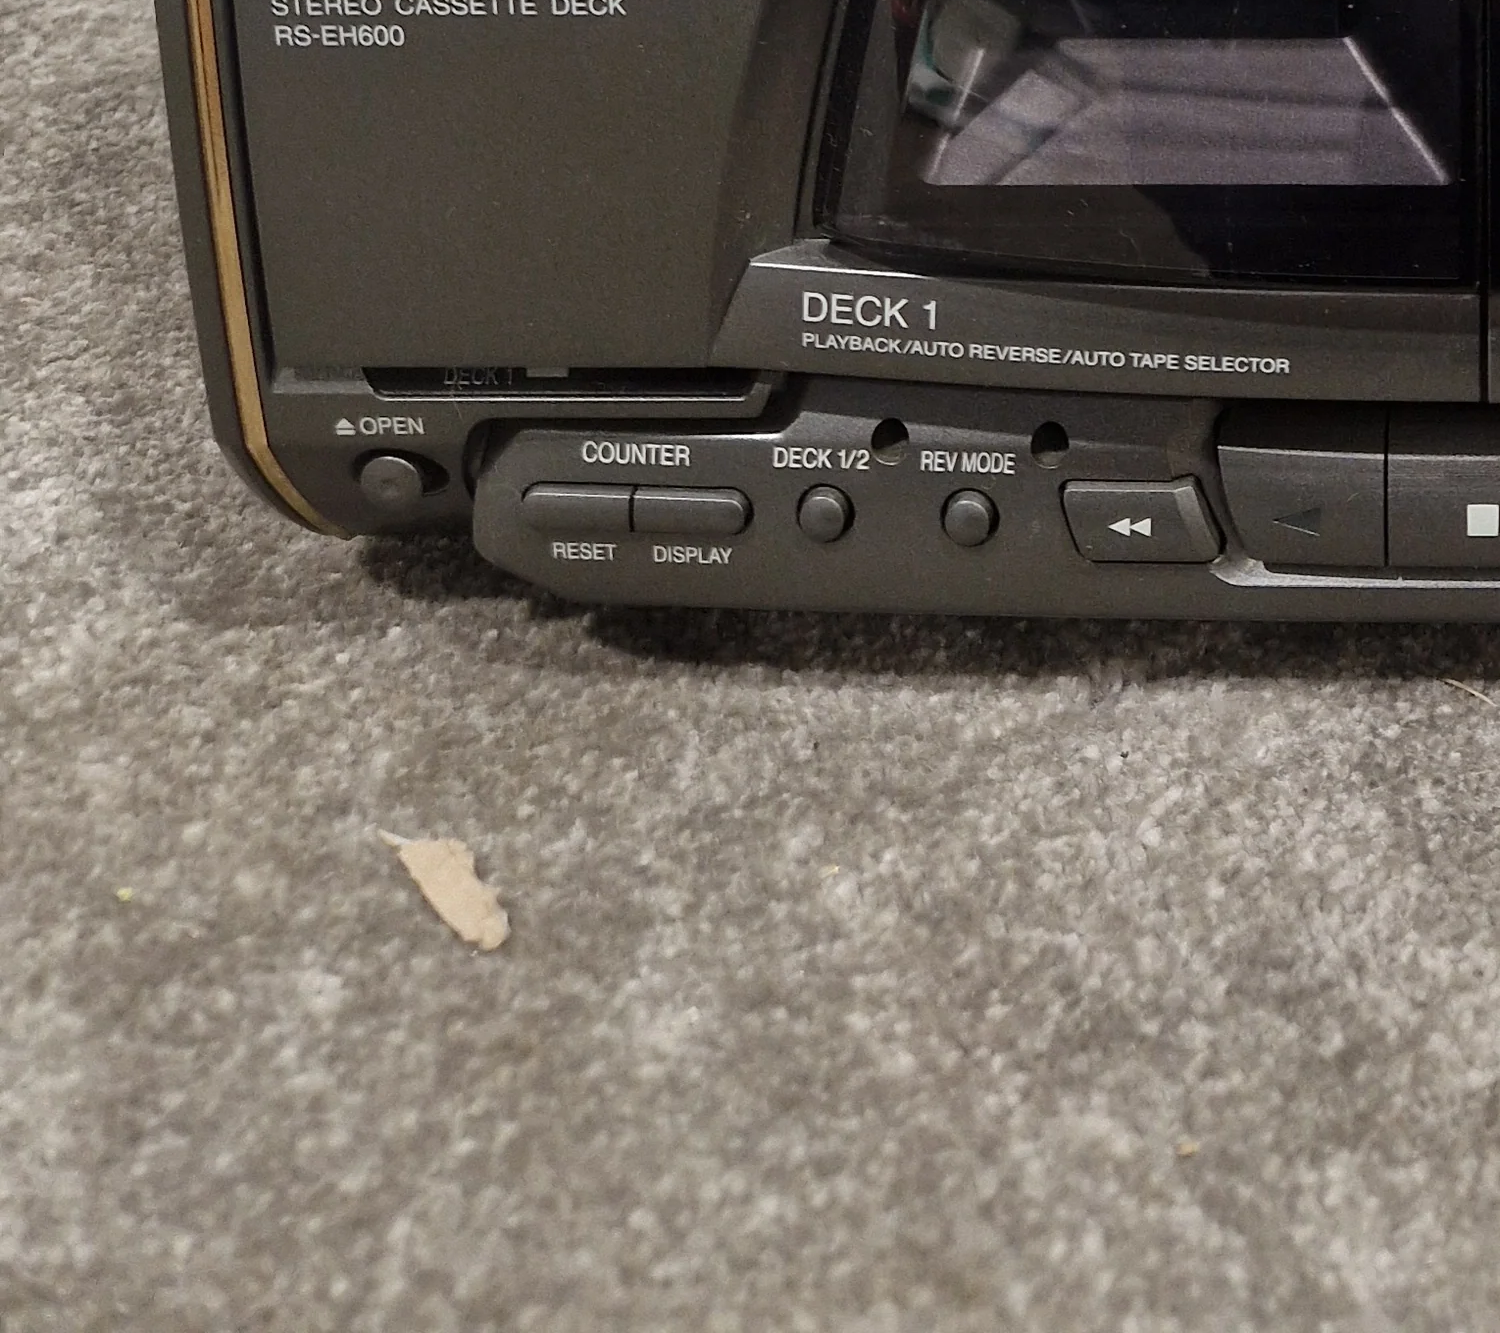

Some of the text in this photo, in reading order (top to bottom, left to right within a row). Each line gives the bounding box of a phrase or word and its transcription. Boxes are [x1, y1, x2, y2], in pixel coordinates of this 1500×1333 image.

[275, 24, 405, 47] RS-EH600
[801, 290, 938, 331] DECK 1
[801, 332, 1291, 374] PLAYBACK/AUTO REVERSE/AUTO TAPE SELECTOR
[443, 367, 499, 386] DECK
[359, 417, 424, 435] OPEN
[581, 441, 691, 467] COUNTER
[772, 447, 870, 470] DECK 1/2
[920, 450, 1017, 475] REV MODE
[552, 542, 617, 562] RESET
[653, 545, 734, 565] DISPLAY
